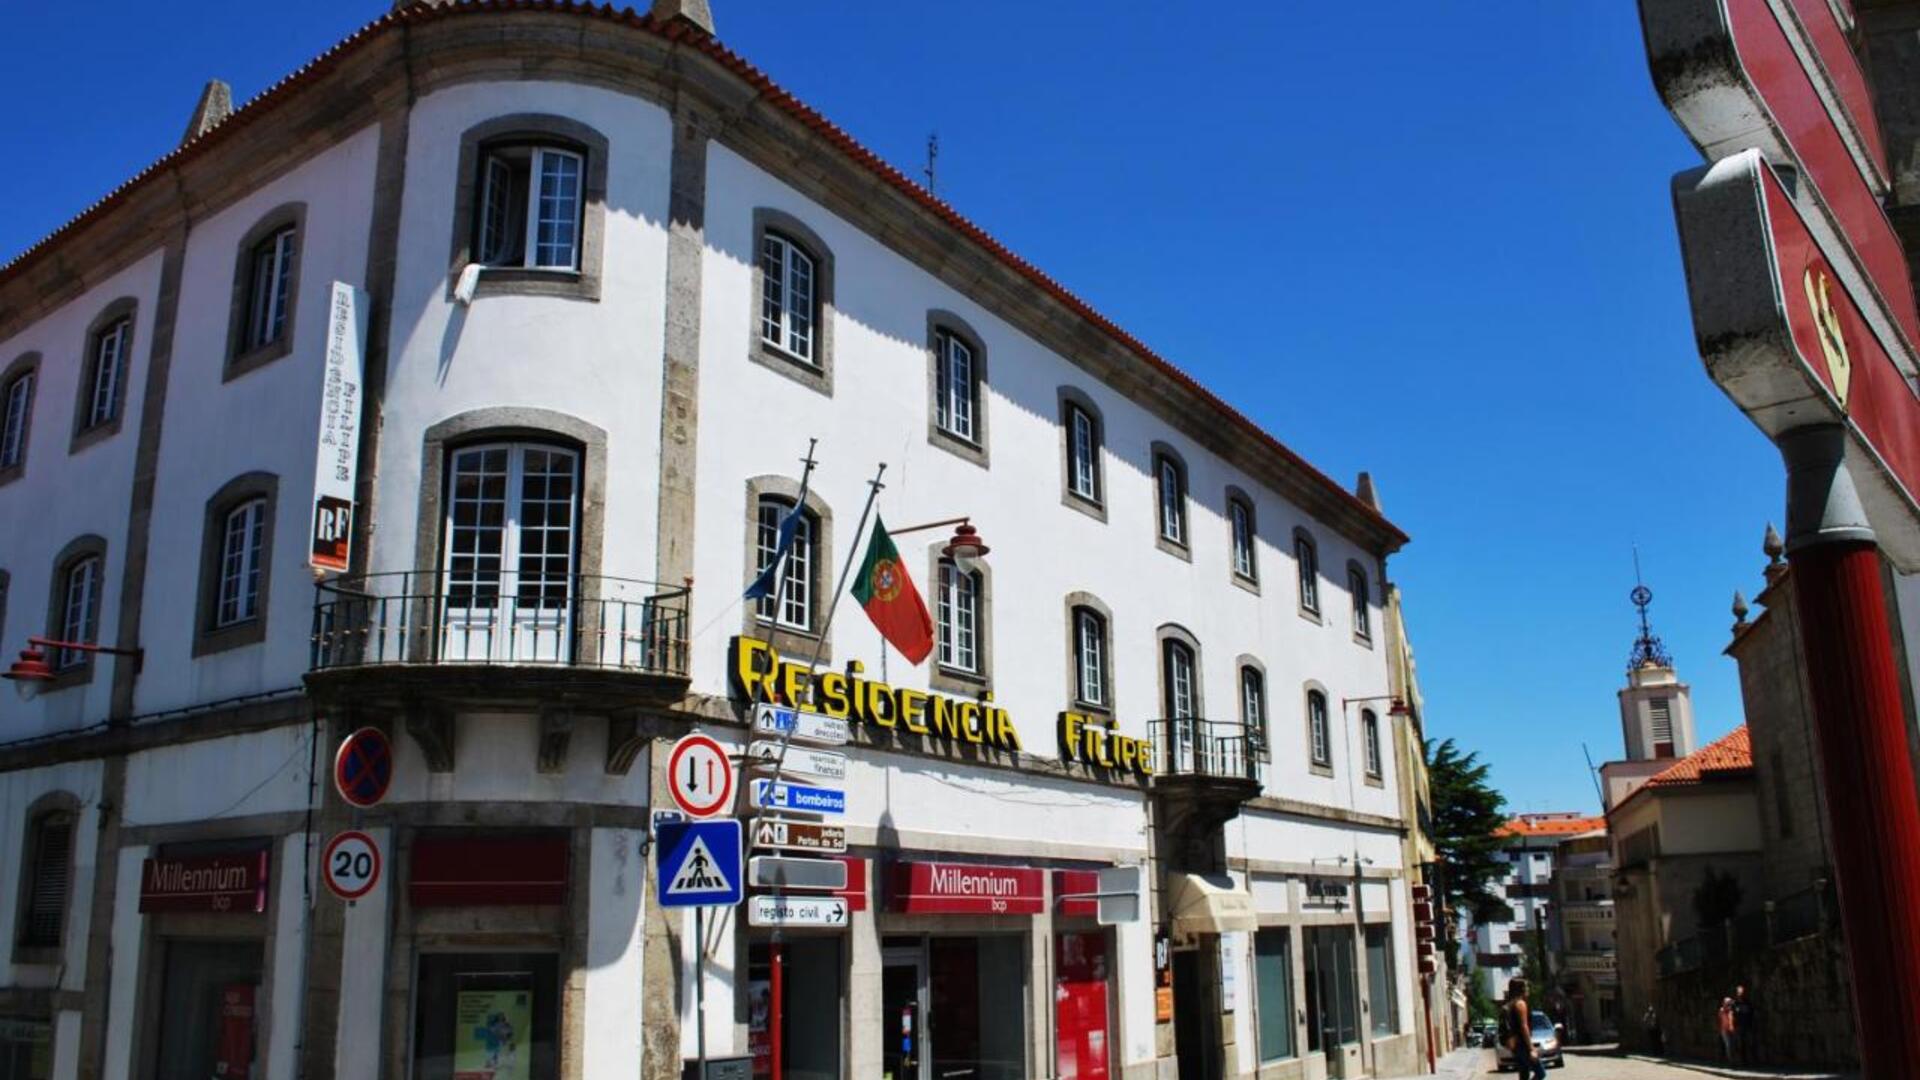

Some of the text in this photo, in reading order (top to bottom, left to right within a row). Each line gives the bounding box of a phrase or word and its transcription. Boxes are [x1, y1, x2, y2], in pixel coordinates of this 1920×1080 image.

[318, 507, 349, 542] RF
[732, 634, 1153, 775] RESIDENCIA FILIPE
[795, 790, 844, 809] bombeiros
[149, 860, 247, 891] Millennium
[335, 851, 372, 879] 20
[930, 864, 1018, 896] Millennium
[759, 905, 794, 919] registo
[799, 905, 819, 918] civil
[991, 898, 1008, 913] bcp
